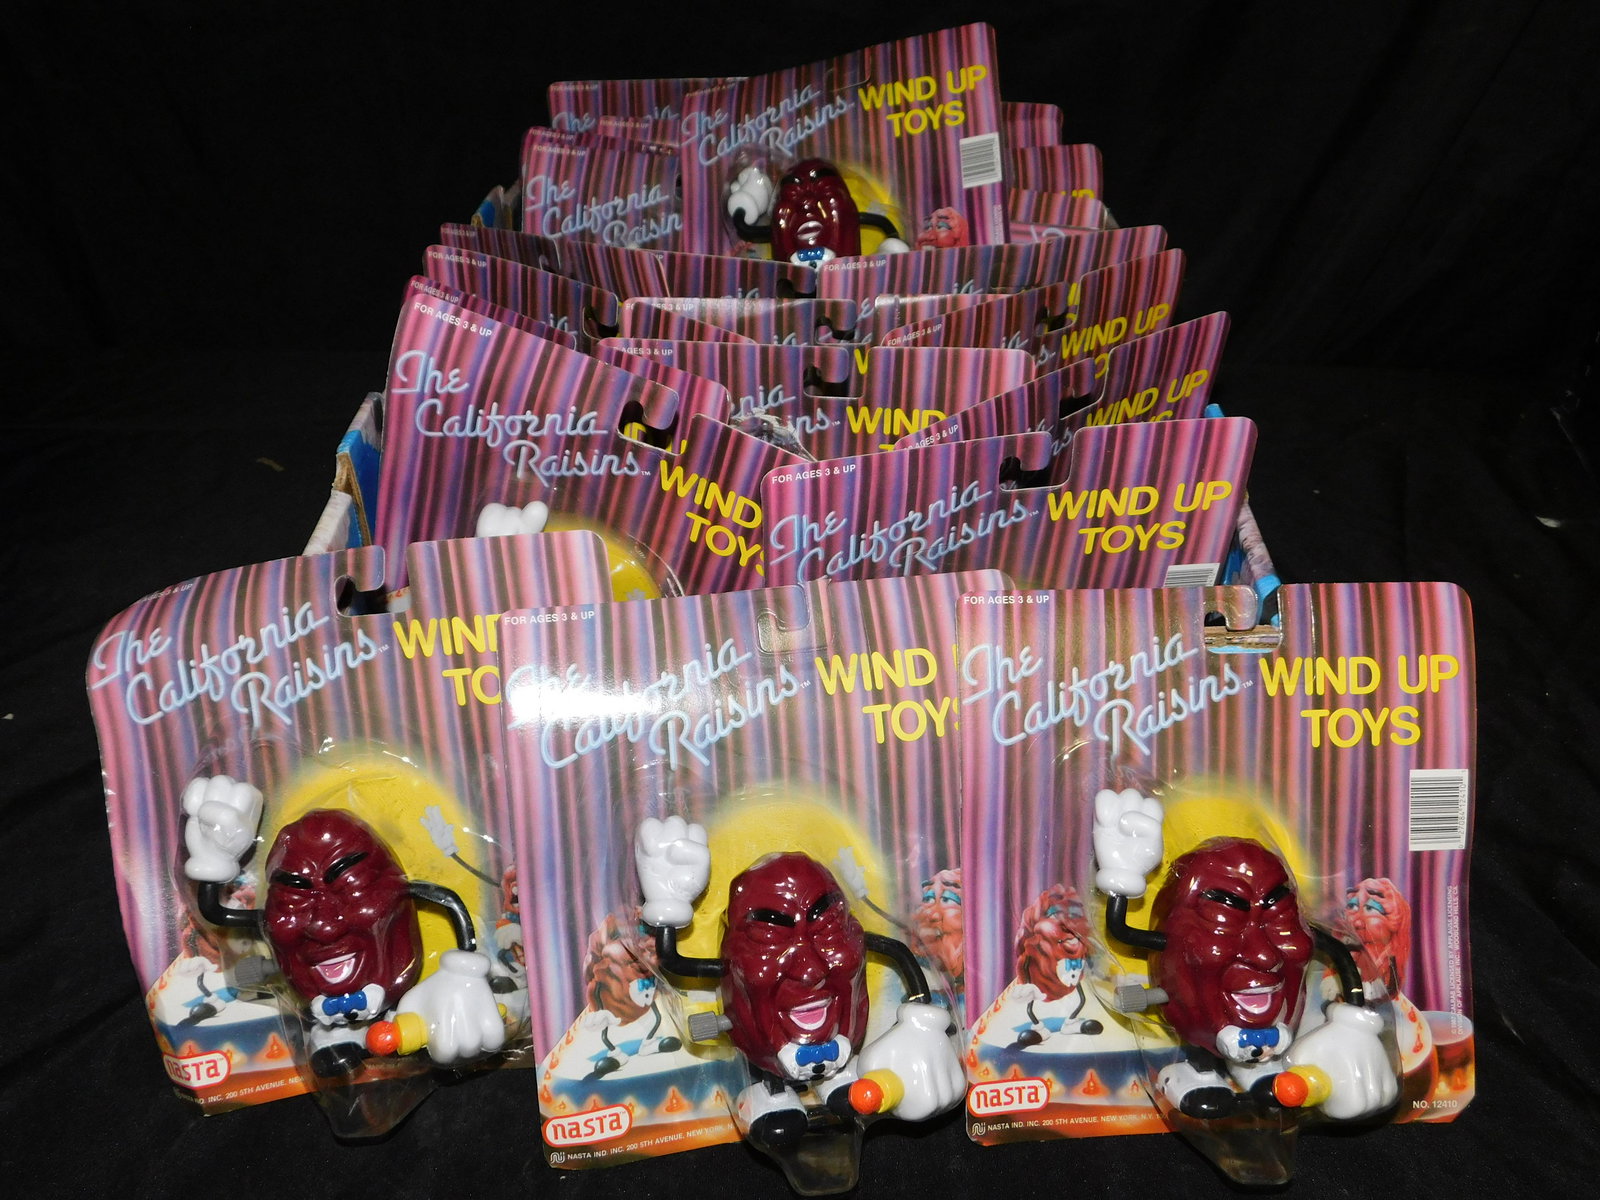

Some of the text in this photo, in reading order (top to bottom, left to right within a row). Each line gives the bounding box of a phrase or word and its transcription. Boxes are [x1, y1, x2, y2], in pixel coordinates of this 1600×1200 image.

[858, 64, 987, 111] WIND UP
[681, 108, 729, 147] The
[698, 84, 821, 166] California
[759, 95, 848, 159] Raisins
[886, 100, 965, 137] TOYS
[525, 174, 576, 211] The
[543, 184, 670, 240] California
[602, 213, 683, 247] Raisin
[428, 250, 444, 259] FOR
[478, 260, 487, 268] UP
[824, 263, 839, 272] FOR
[841, 262, 862, 270] AGES
[876, 259, 887, 267] UP
[411, 280, 424, 290] FOR
[424, 284, 440, 296] AGES
[450, 294, 459, 302] UP
[682, 303, 694, 311] UP
[414, 302, 493, 337] FOR AGES 3 & UP
[888, 337, 901, 347] FOR
[902, 331, 920, 342] AGES
[932, 323, 942, 332] UP
[1062, 316, 1128, 360] WIND
[1134, 303, 1170, 335] UP
[392, 350, 470, 395] The
[662, 348, 673, 356] UP
[1086, 387, 1159, 427] WIND
[1166, 369, 1209, 403] UP
[415, 399, 608, 447] California
[846, 406, 947, 435] WIND
[936, 432, 941, 440] 3
[942, 430, 948, 438] &
[948, 424, 958, 434] UP
[503, 439, 640, 488] Raisins
[771, 464, 856, 484] FOR AGES 3 & UP
[660, 460, 763, 529] WIND
[1048, 480, 1232, 522] WIND UP
[770, 511, 848, 566] The
[797, 480, 993, 584] California
[889, 500, 1029, 576] Raisins
[1078, 520, 1186, 555] TOYS
[504, 610, 595, 626] FOR AGES 3 & UP
[964, 595, 1050, 604] FOR AGES 3 & UP
[92, 628, 172, 689] The
[126, 602, 330, 725] California
[231, 628, 378, 728] Raisins
[814, 648, 938, 696] WIND
[962, 642, 1044, 705] The
[1258, 654, 1460, 697] WIND UP
[442, 664, 501, 706] TO
[992, 632, 1199, 746] California
[649, 664, 800, 771] Raisins
[862, 696, 959, 744] TOY
[1094, 663, 1241, 756] Raisins
[1300, 706, 1421, 749] TOYS
[226, 1090, 238, 1100] 200
[240, 1088, 254, 1096] 5TH
[1412, 1100, 1458, 1108] NO. 12410
[640, 1140, 653, 1148] 5TH
[686, 1128, 703, 1138] NEW
[988, 1123, 1010, 1131] NASTA
